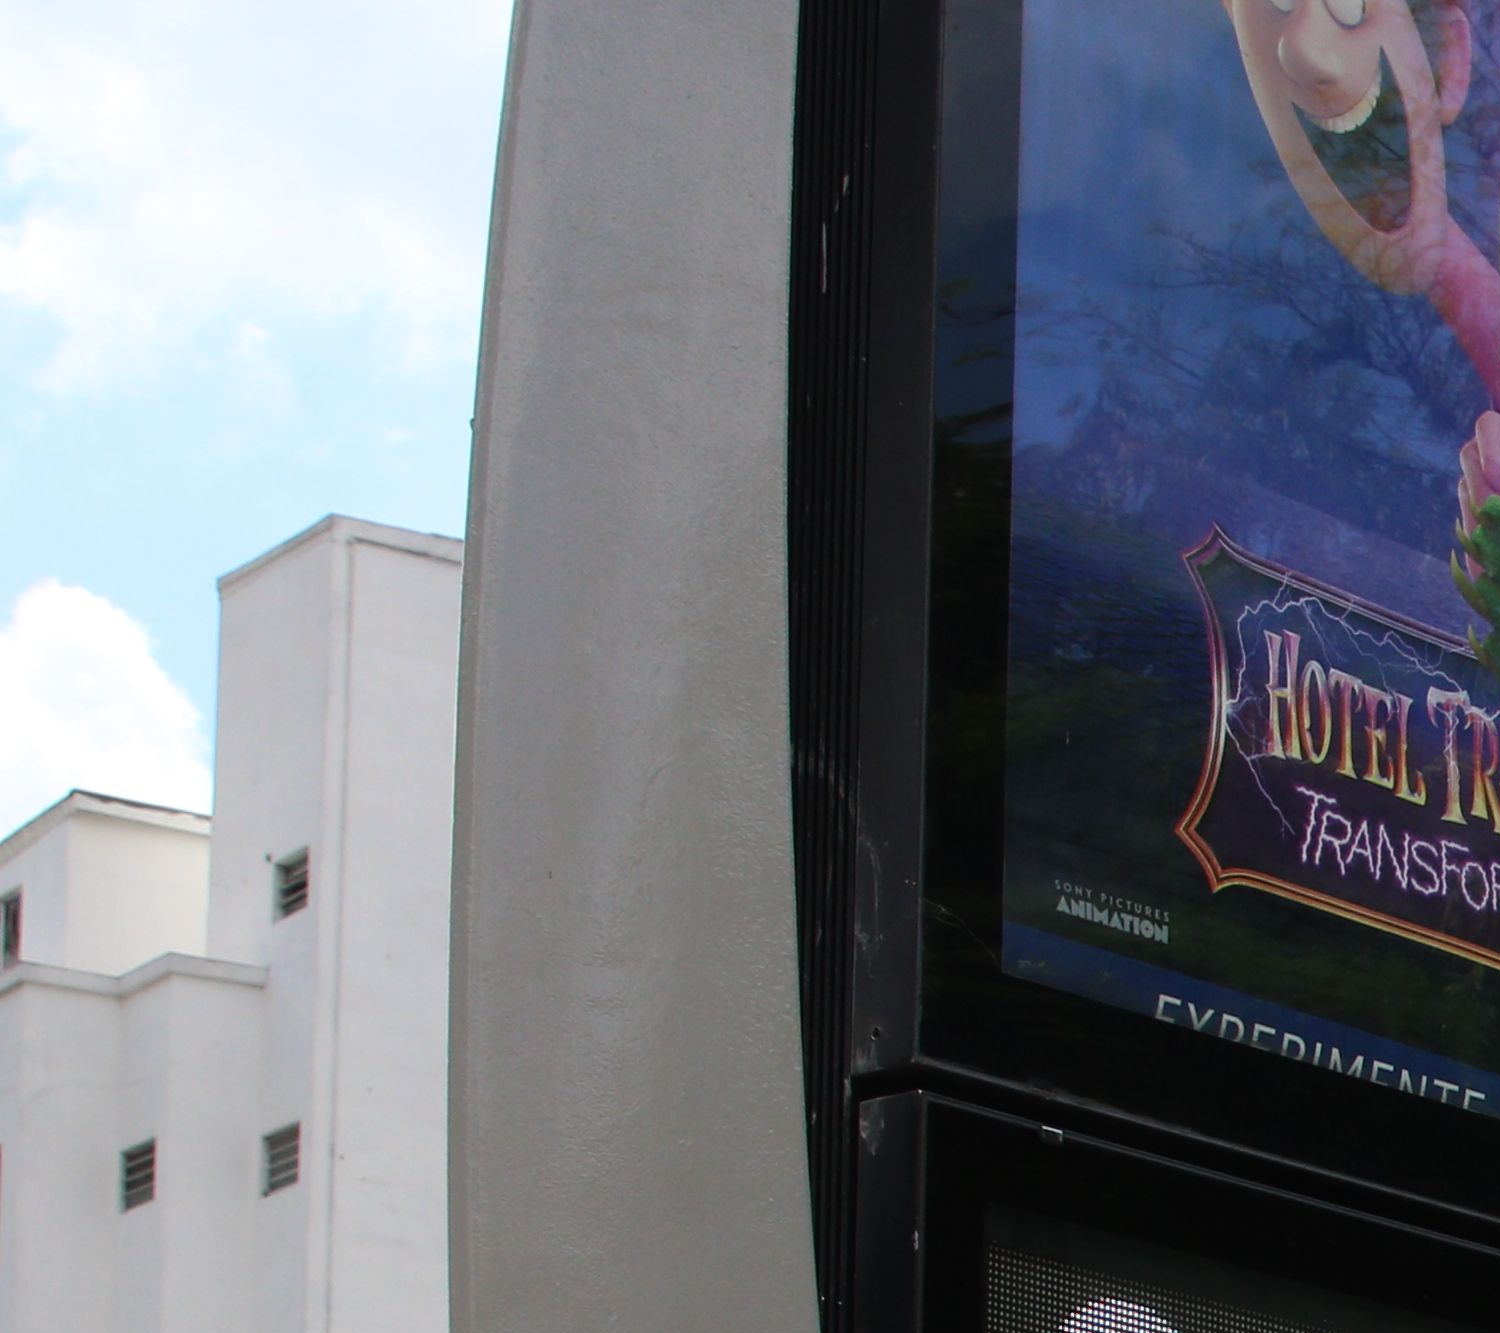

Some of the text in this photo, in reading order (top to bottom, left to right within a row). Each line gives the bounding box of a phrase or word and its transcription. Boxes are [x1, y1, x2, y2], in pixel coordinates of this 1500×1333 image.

[1264, 628, 1427, 806] HOTEL
[1054, 879, 1170, 922] SONY PICTURES
[1056, 894, 1170, 945] ANIMATION
